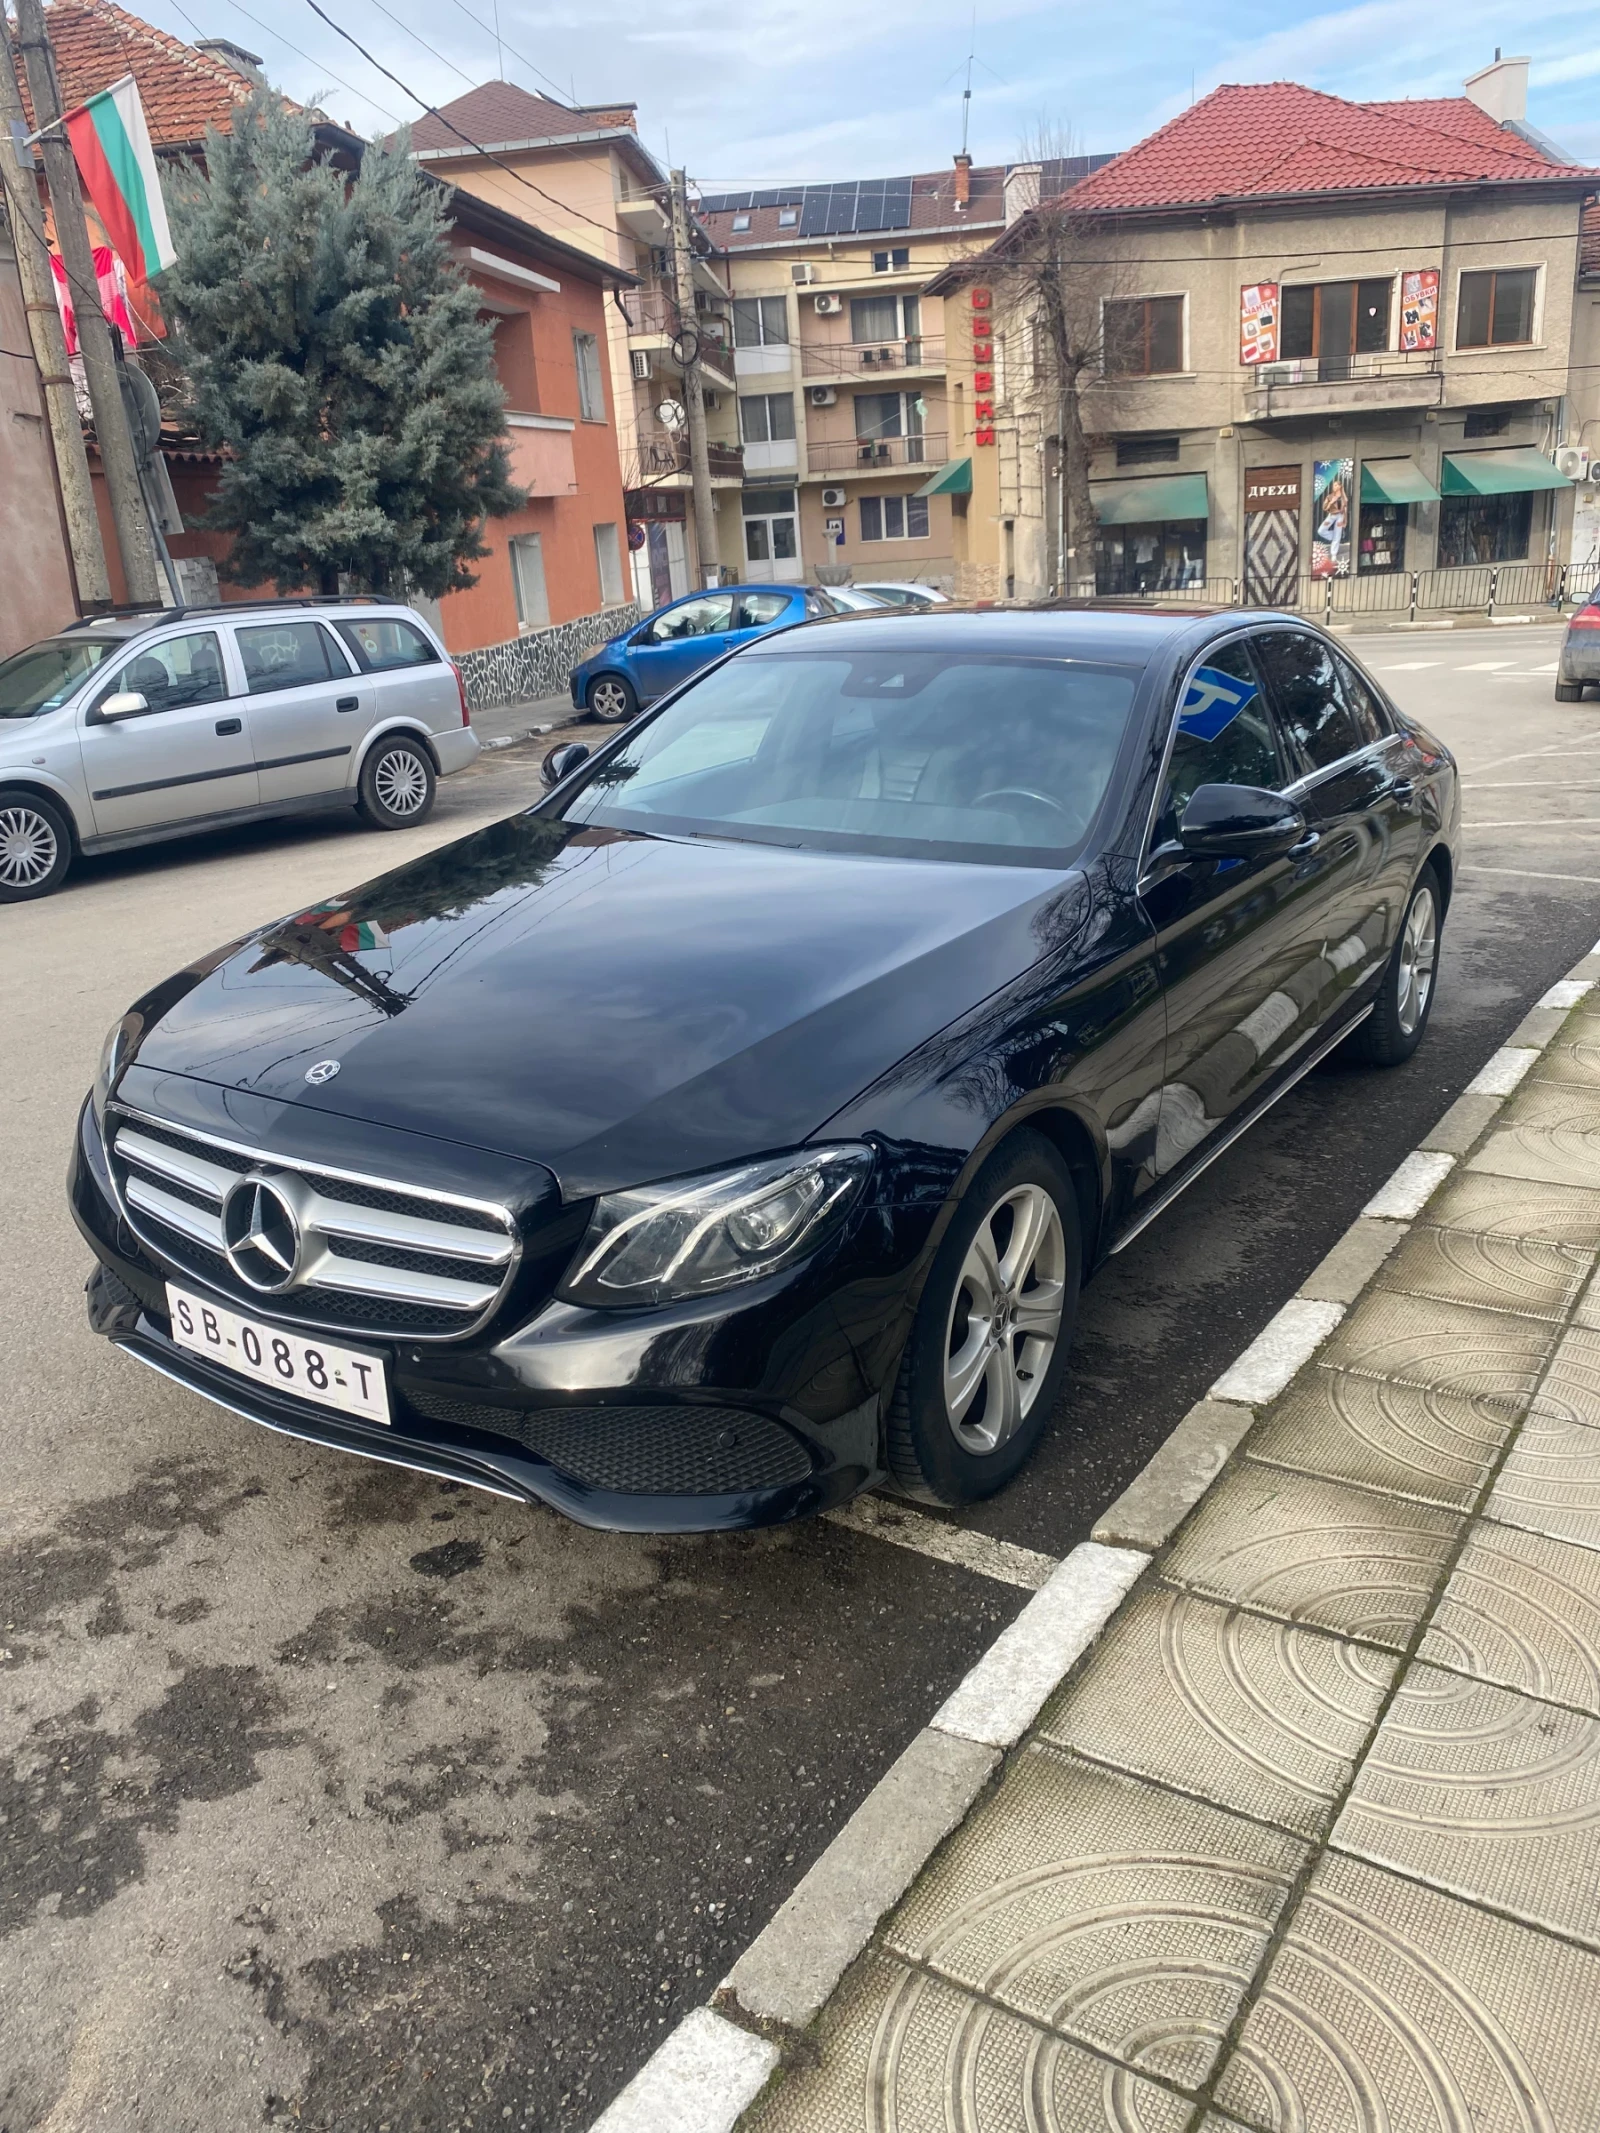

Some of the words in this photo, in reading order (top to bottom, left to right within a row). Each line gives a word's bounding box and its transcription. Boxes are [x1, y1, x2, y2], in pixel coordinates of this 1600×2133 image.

[1404, 287, 1436, 304] ОБУВКИ
[1244, 300, 1274, 315] ЧАНТИ
[972, 288, 995, 446] ОБУВКИ
[1248, 484, 1297, 498] ДРЕХИ
[177, 1299, 372, 1400] SB-088-T
